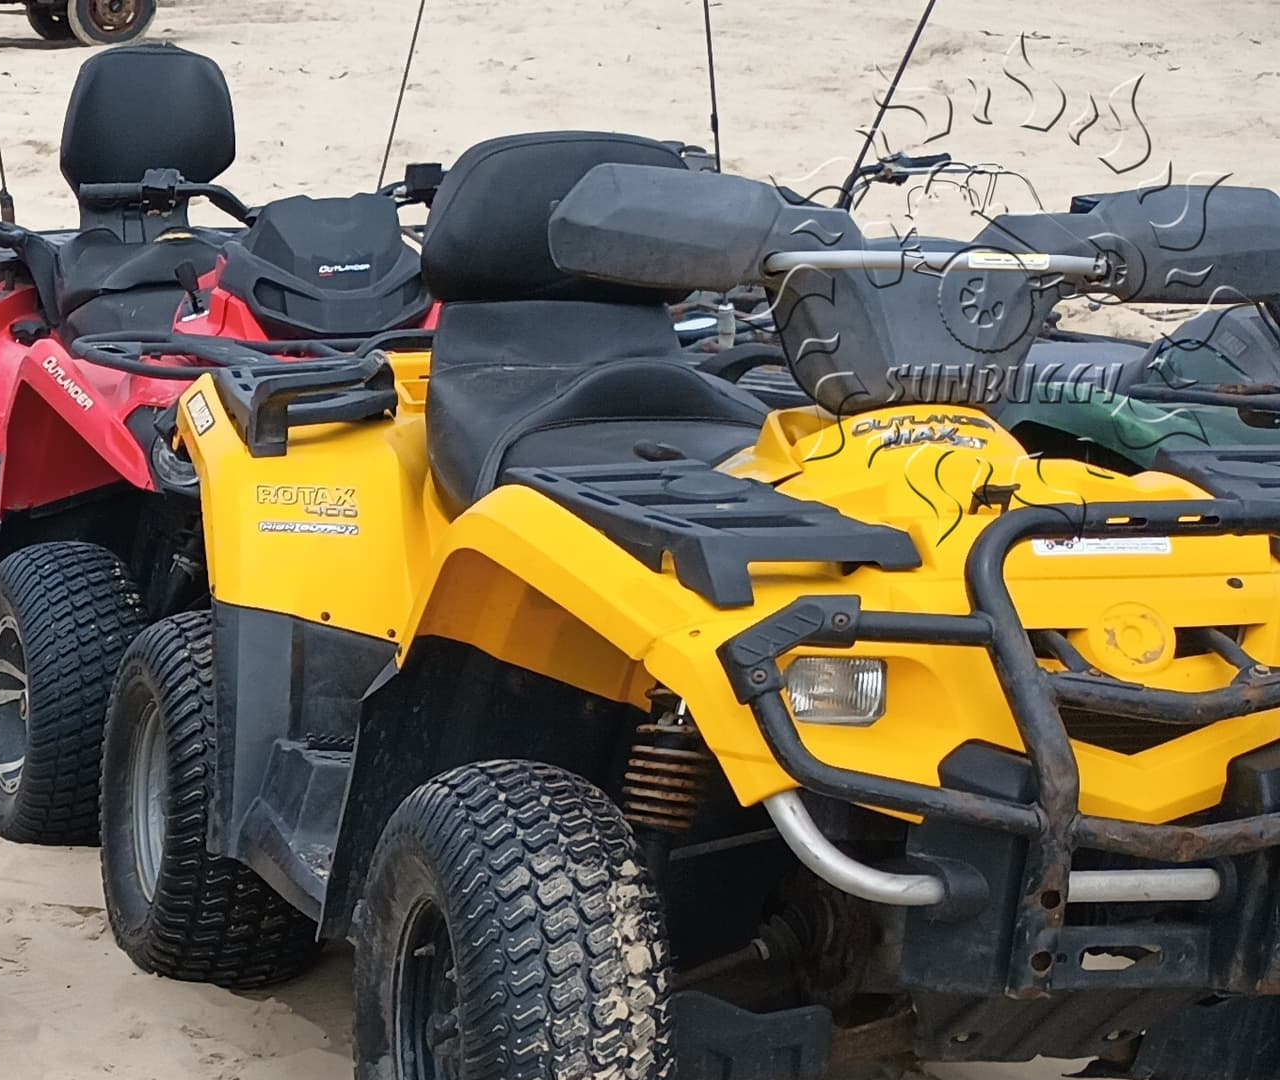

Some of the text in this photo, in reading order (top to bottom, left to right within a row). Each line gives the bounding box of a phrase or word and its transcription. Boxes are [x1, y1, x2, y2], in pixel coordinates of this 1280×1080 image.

[42, 355, 94, 412] OUTLANDER
[256, 485, 357, 507] ROTAX
[304, 505, 359, 518] 400
[298, 523, 358, 535] OUTPUT
